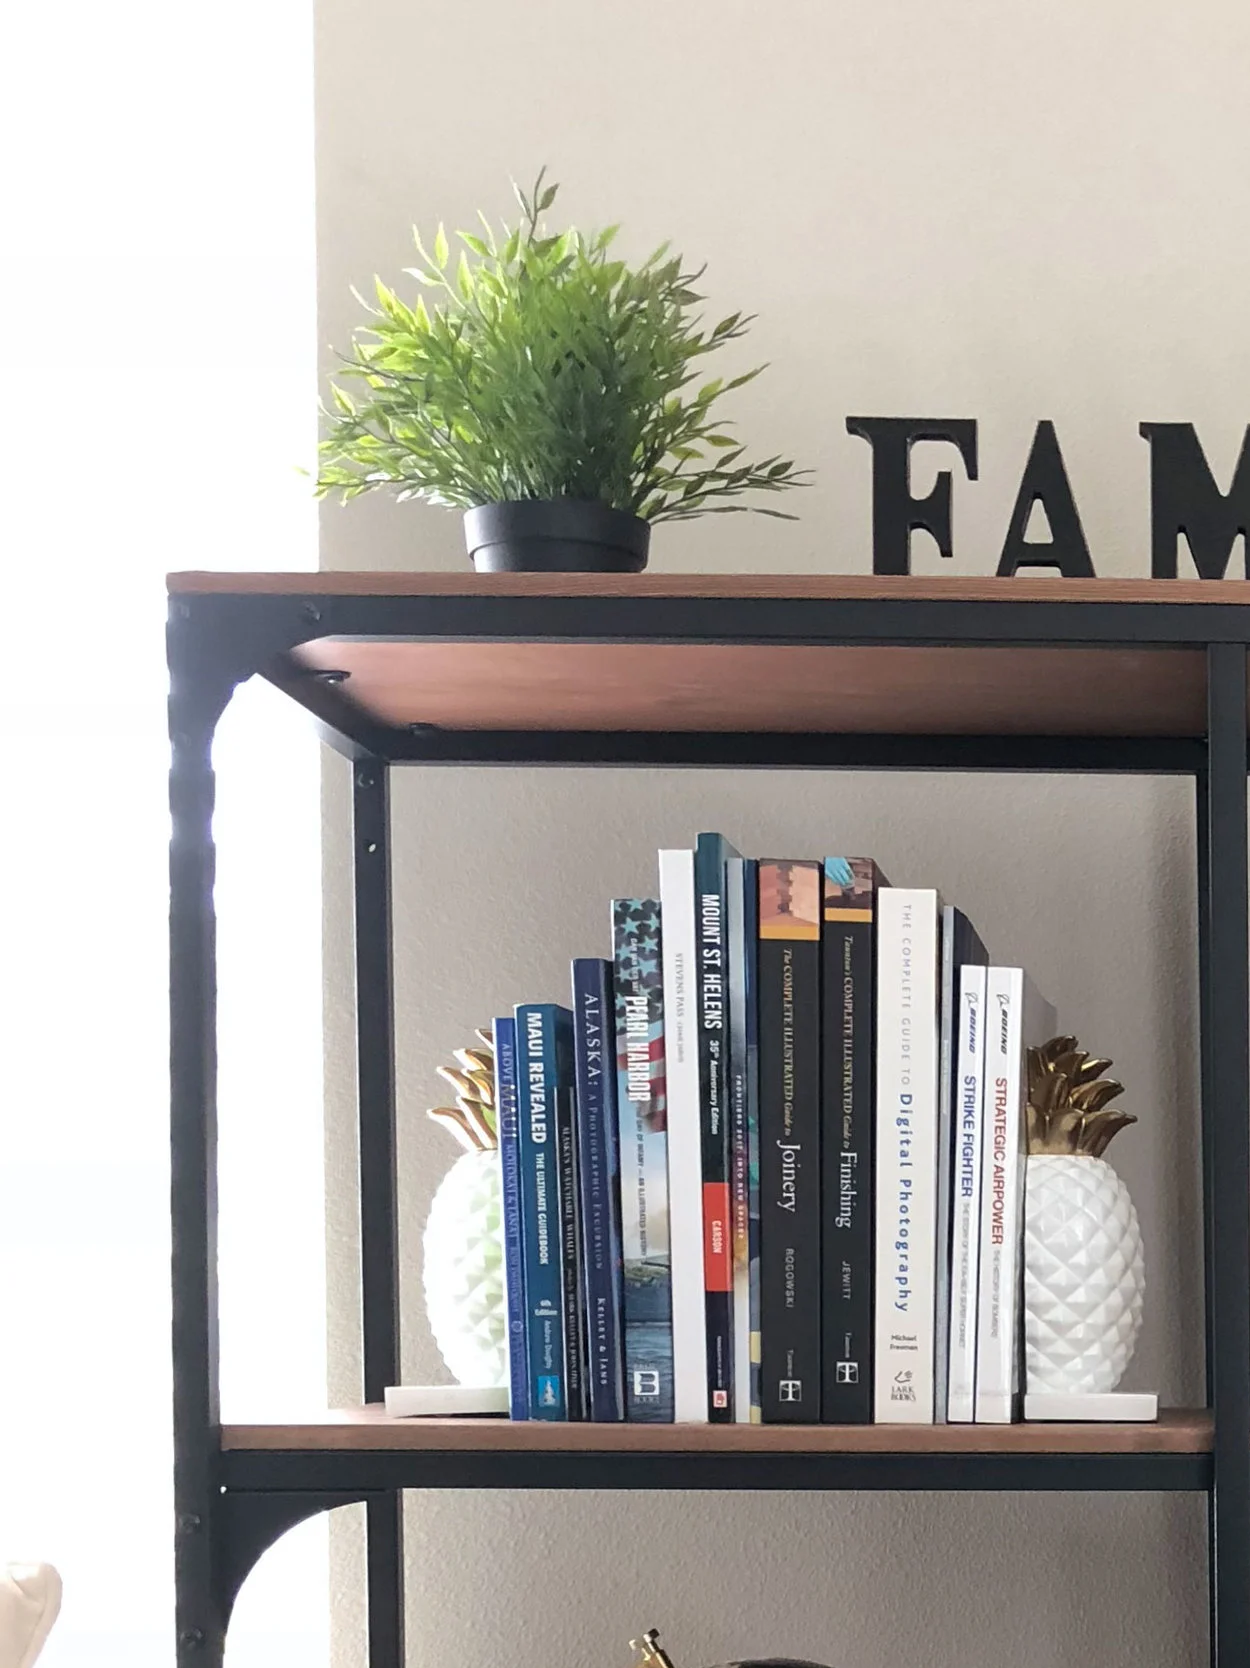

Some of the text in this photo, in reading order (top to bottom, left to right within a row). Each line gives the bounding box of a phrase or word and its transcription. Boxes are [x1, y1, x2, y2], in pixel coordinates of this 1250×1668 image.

[702, 894, 721, 945] MOUNT
[703, 948, 721, 970] ST.
[784, 965, 794, 1025] COMPLETE
[704, 974, 723, 1030] HELENS
[843, 976, 854, 1037] COMPLETE
[585, 993, 602, 1086] ALASKA:
[624, 995, 651, 1102] PEARL HARBOR
[784, 1027, 794, 1101] ILLUSTRATED
[842, 1039, 853, 1114] ILLUSTRATED
[527, 1012, 549, 1265] MAUI REVEALED THE ULTIMATE GUIDEBOOK
[711, 1108, 720, 1135] Edition
[894, 904, 913, 1313] THE COMPLETE GUIDE TO Digital Photography
[961, 1075, 977, 1198] STRIKE FIGHTER
[993, 1077, 1008, 1161] STRATEGIC
[776, 1139, 802, 1213] Joinery
[835, 1151, 858, 1229] Finishing
[991, 1164, 1006, 1245] AIRPOWER
[711, 1220, 722, 1254] CARSON
[785, 1248, 796, 1309] ROGOWSKI
[842, 1260, 852, 1300] JEWITT
